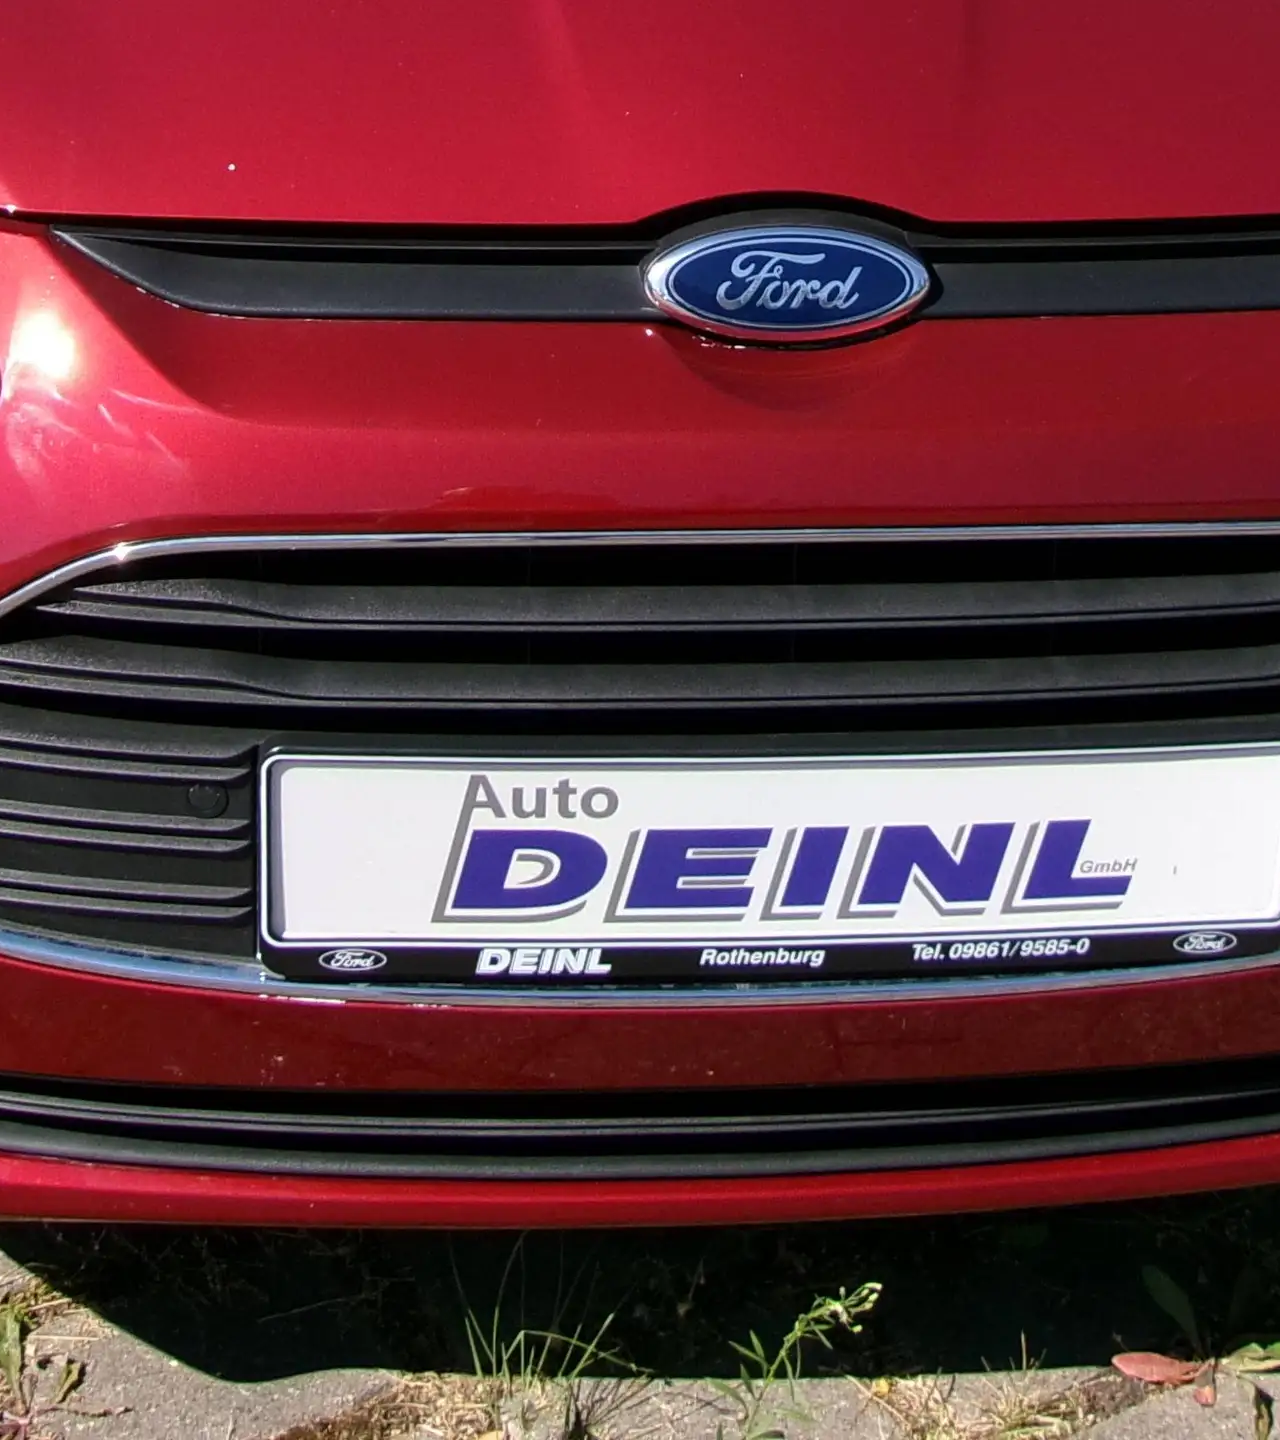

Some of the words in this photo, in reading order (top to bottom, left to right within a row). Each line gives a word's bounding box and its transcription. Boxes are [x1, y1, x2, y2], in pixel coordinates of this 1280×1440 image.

[716, 250, 863, 310] Ford
[464, 773, 621, 822] Auto
[431, 817, 1134, 924] DEINL
[1079, 857, 1139, 874] GmbH
[330, 948, 374, 968] Ford
[475, 947, 612, 976] DEINL
[699, 947, 826, 968] Rothenburg
[912, 942, 945, 960] Tel.
[949, 937, 1090, 960] 09861/9585-0
